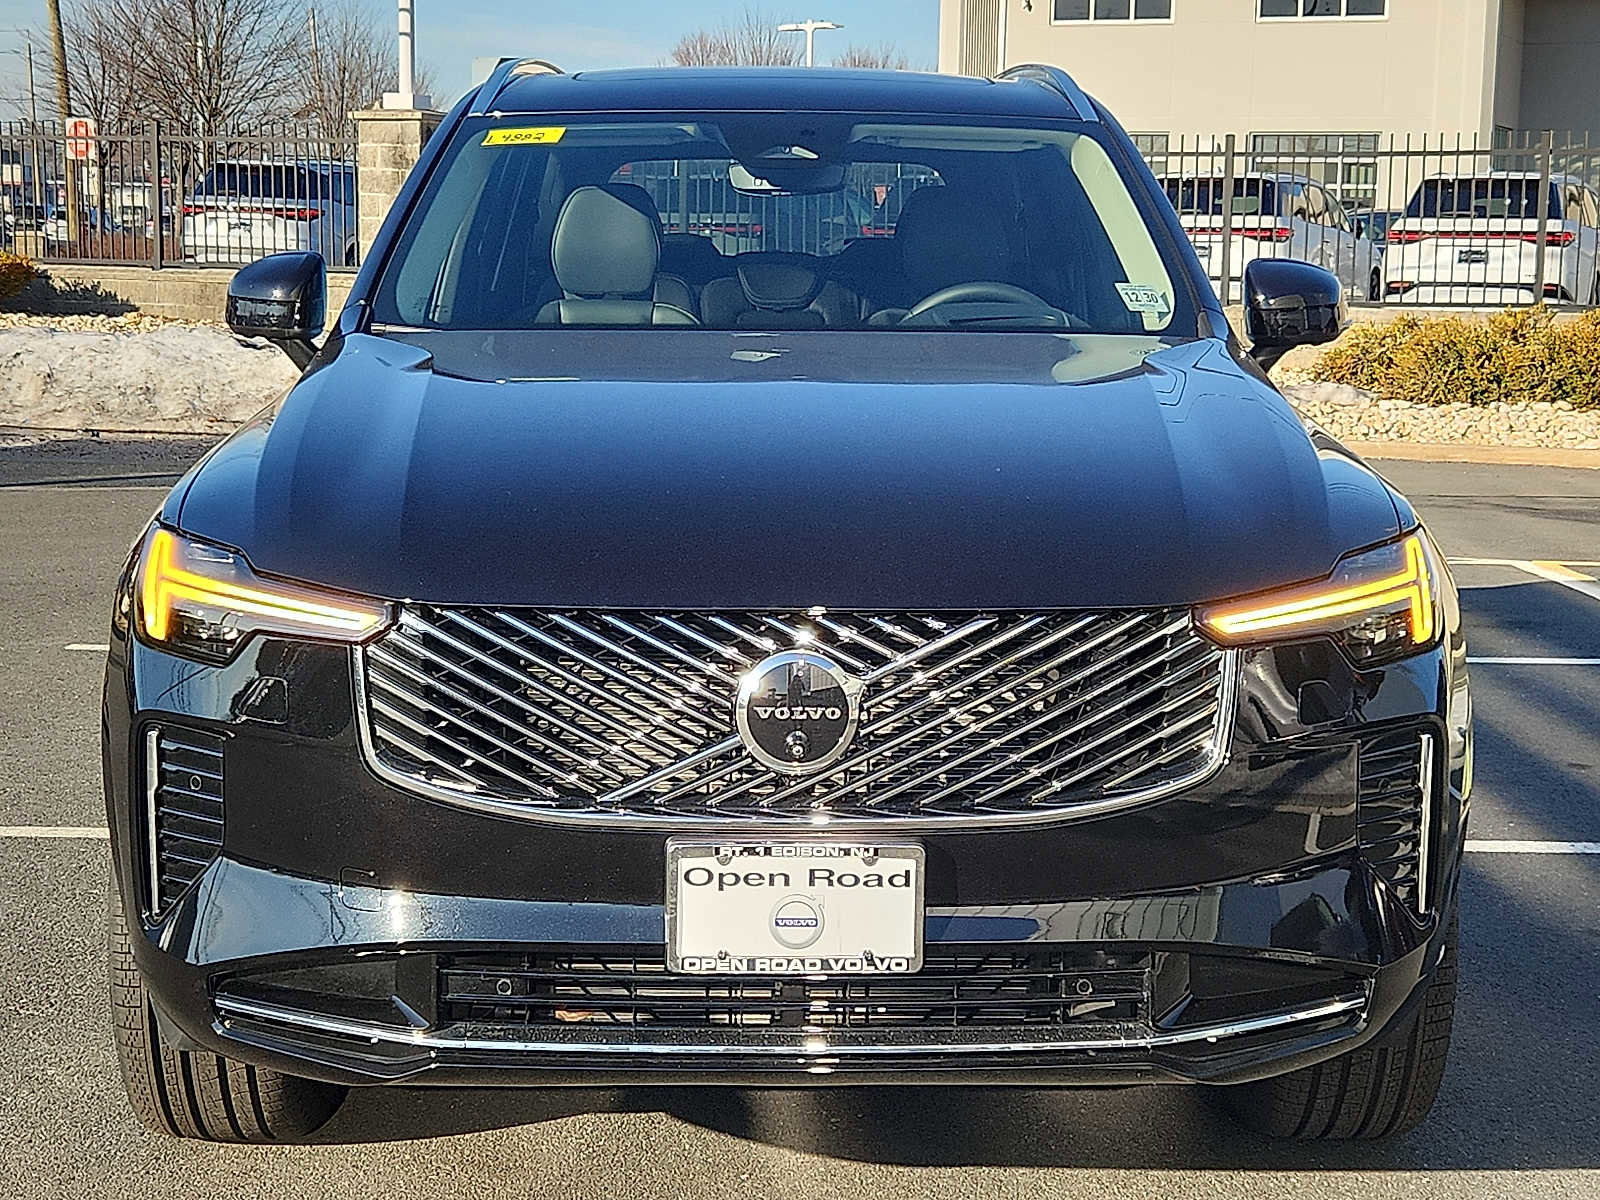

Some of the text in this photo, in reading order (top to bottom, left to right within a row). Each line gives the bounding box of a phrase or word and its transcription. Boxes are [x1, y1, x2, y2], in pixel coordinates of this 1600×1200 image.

[753, 706, 842, 720] VOLVO
[755, 846, 766, 858] 1
[851, 847, 875, 858] NJ
[683, 867, 912, 891] Open Road
[683, 957, 909, 972] OPEN ROAD VOLVO
